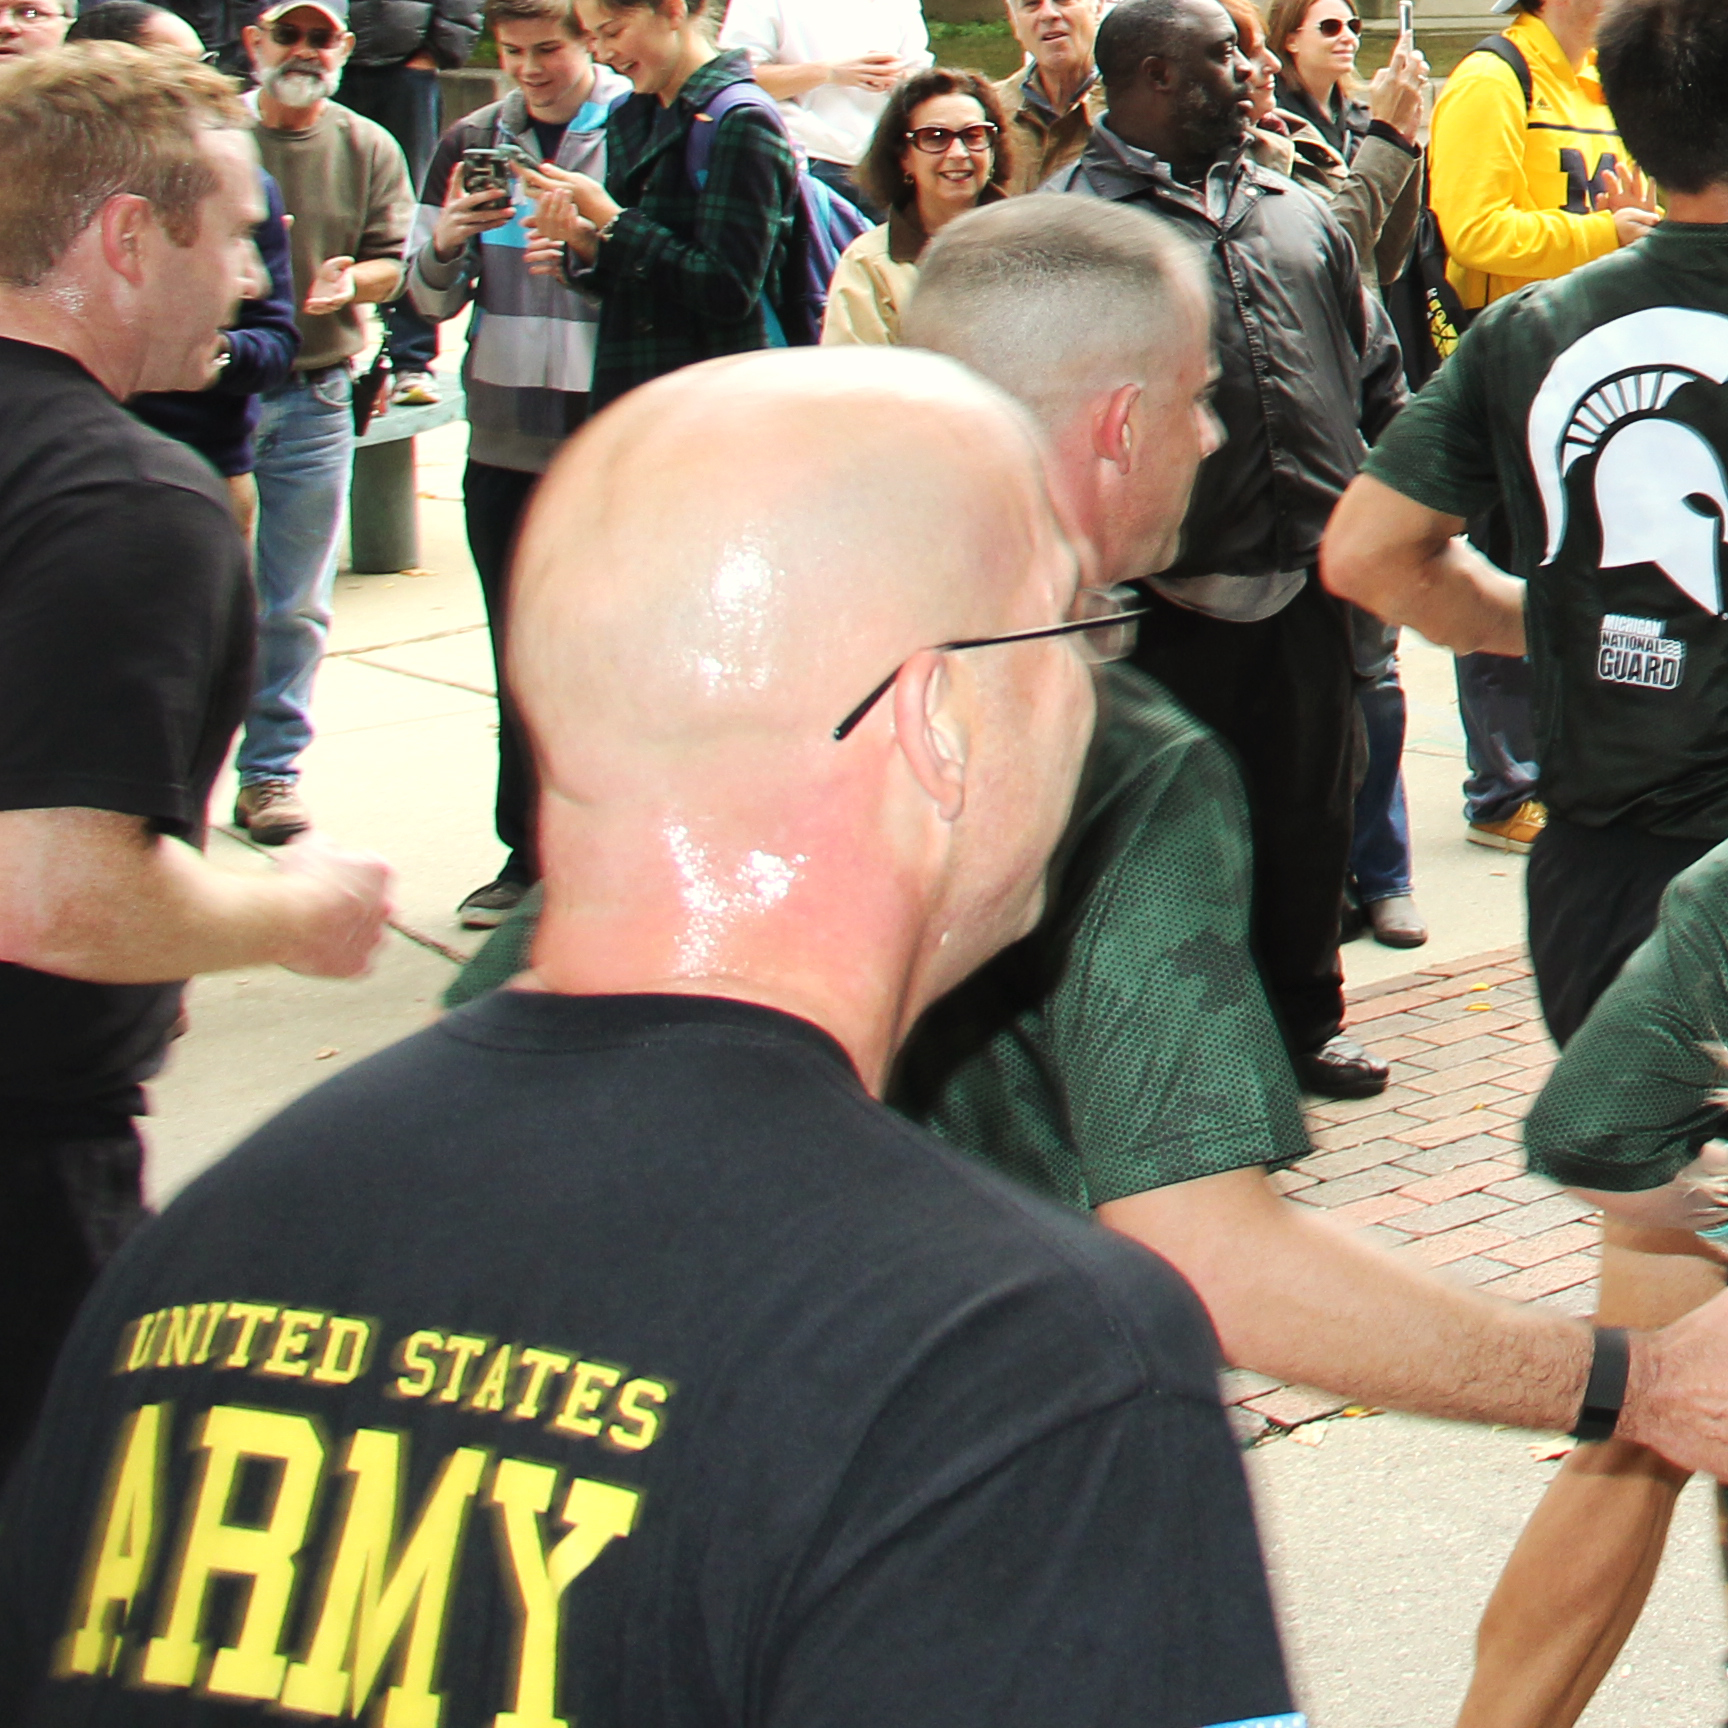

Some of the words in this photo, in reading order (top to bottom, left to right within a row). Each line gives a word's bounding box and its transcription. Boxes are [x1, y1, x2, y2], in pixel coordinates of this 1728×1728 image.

[1600, 649, 1678, 687] GUARD
[1602, 632, 1663, 653] NATIONAL
[122, 1301, 373, 1385] UNITED
[394, 1329, 670, 1452] STATES
[68, 1402, 641, 1728] ARMY
